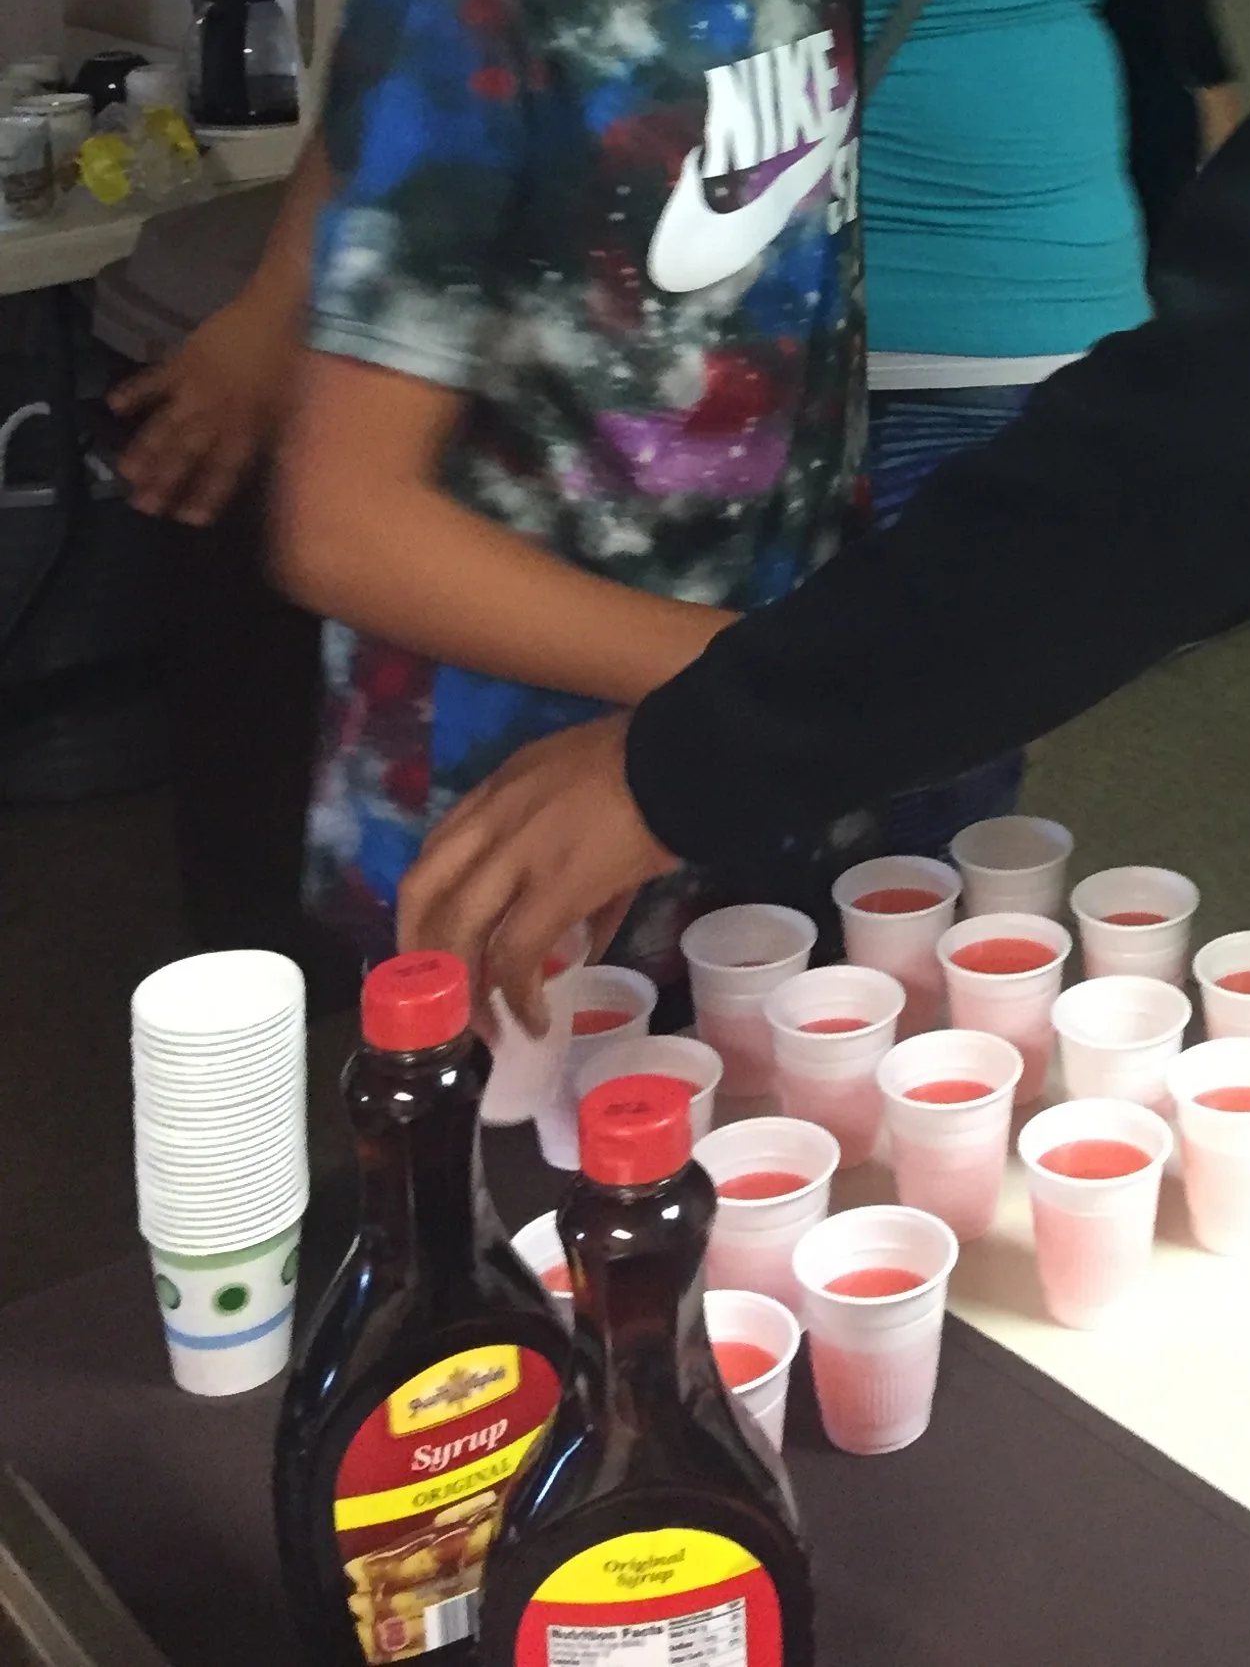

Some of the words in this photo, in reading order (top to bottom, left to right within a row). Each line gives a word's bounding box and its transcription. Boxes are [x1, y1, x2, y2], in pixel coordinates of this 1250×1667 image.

[702, 28, 846, 180] NIKE
[410, 1418, 509, 1473] Syrup
[411, 1457, 512, 1509] ORIGINAL
[602, 1548, 687, 1575] Original
[616, 1568, 676, 1588] Syrup
